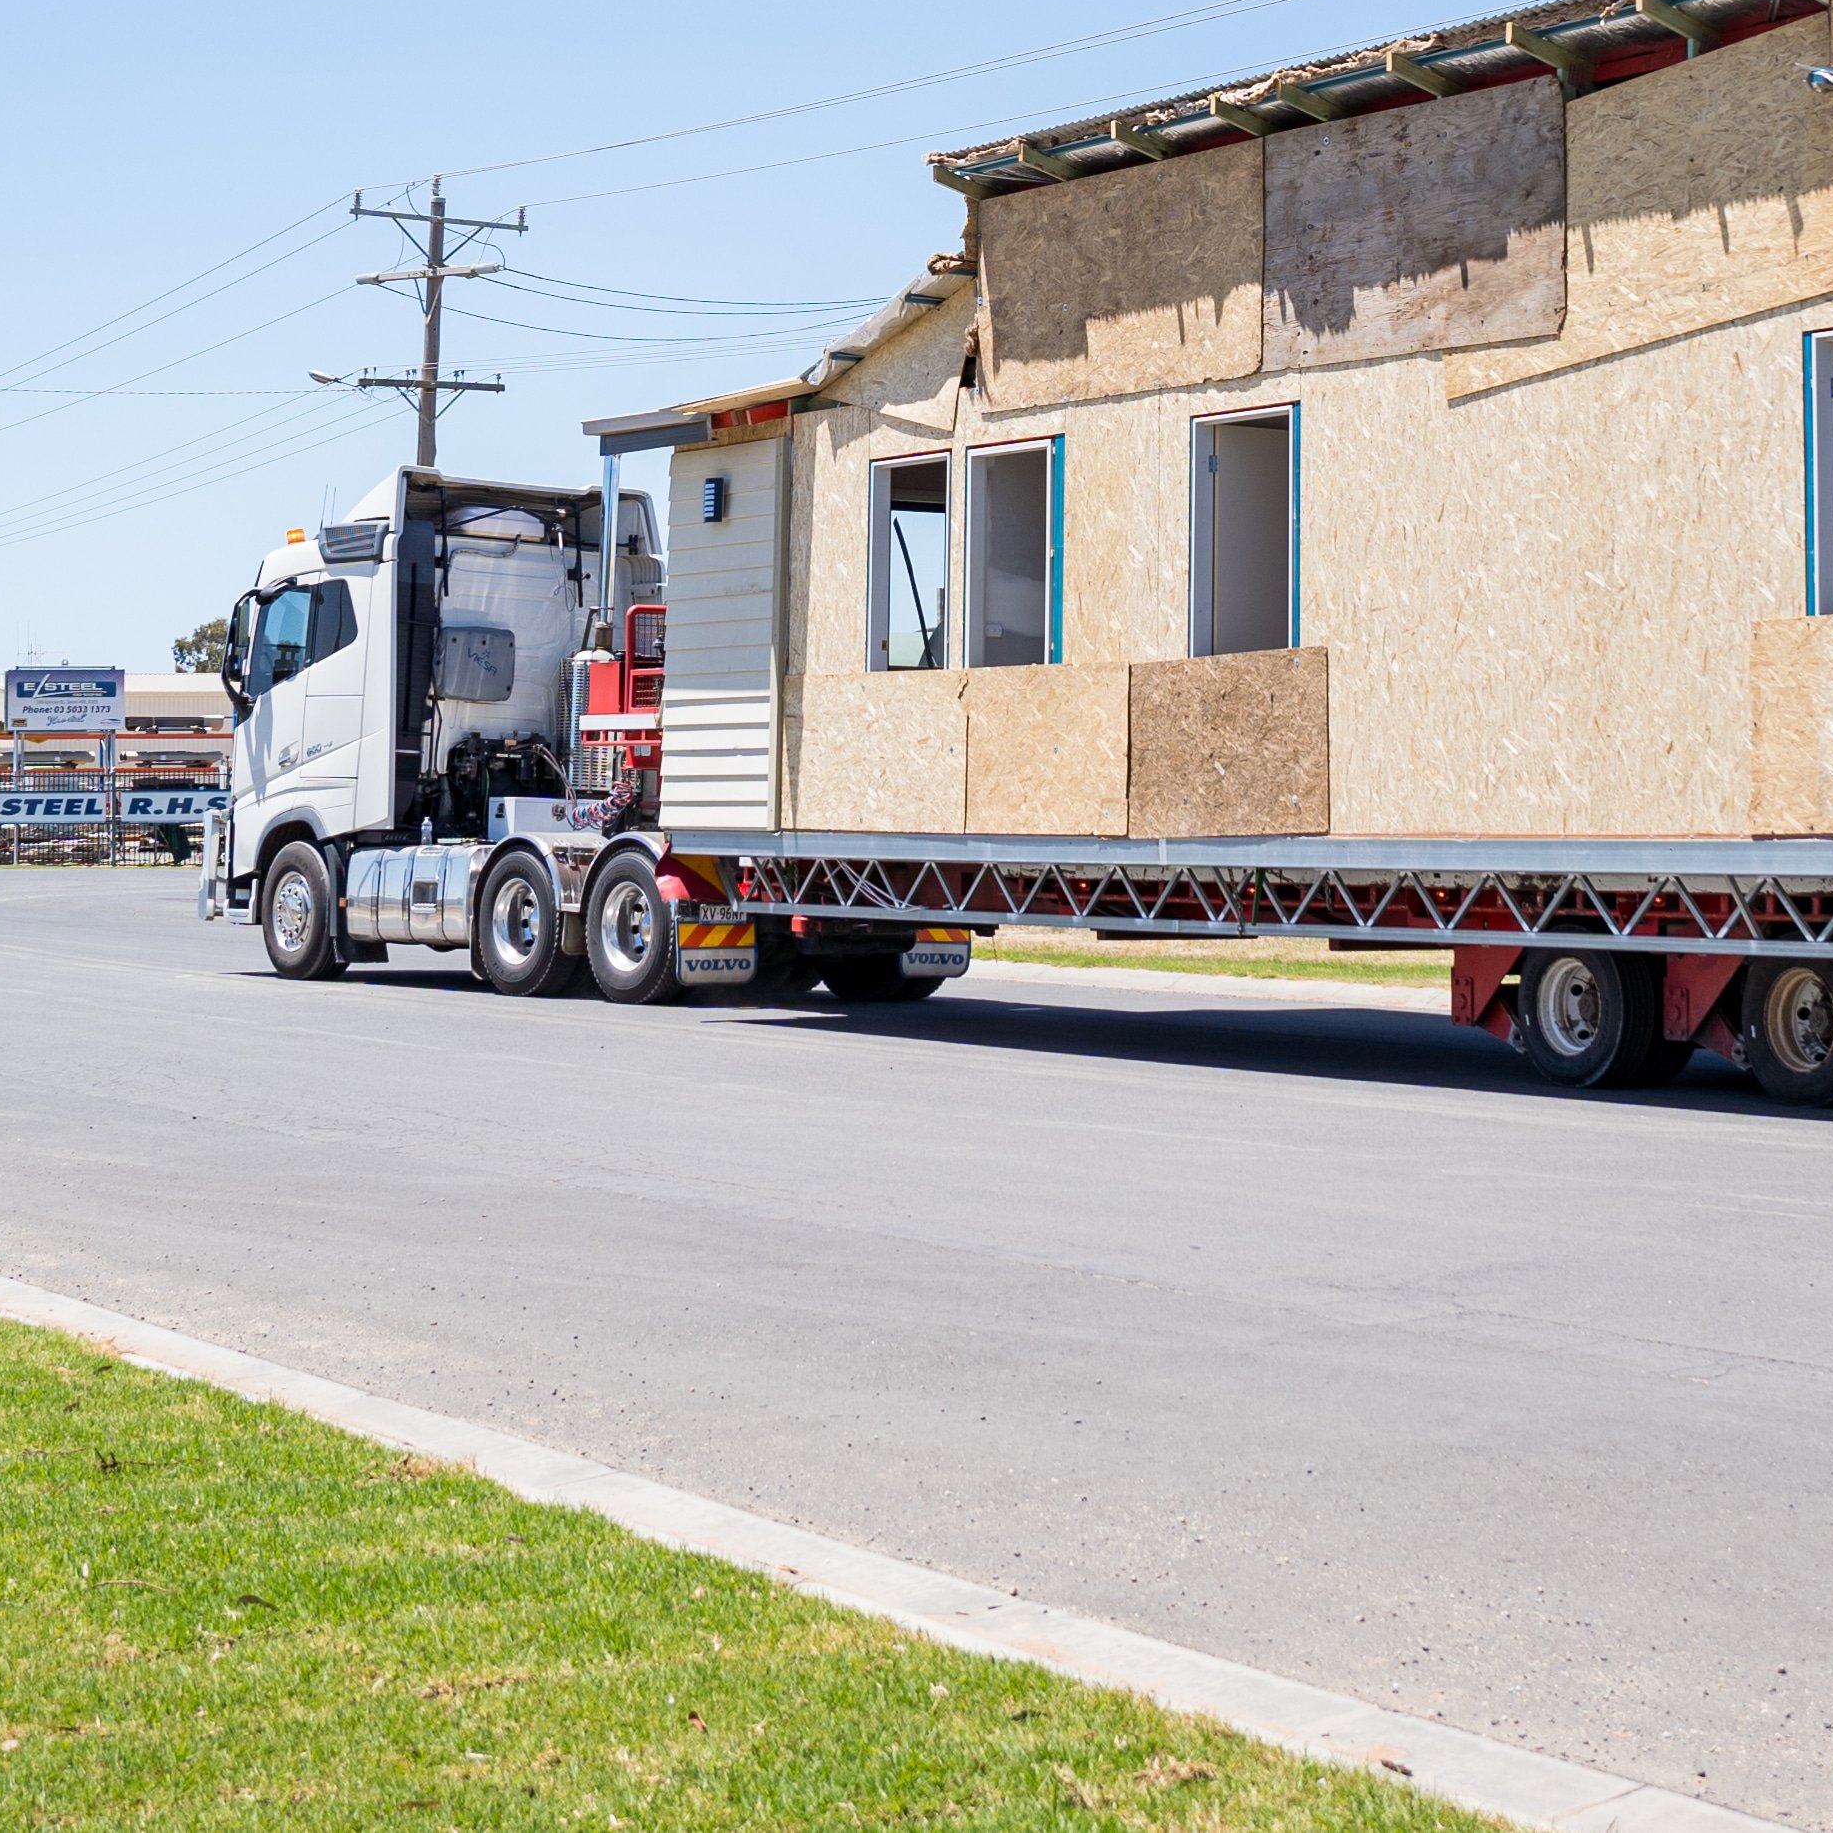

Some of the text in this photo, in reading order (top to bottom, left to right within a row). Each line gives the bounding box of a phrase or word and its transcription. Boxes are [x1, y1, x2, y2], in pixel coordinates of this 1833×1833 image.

[22, 705, 53, 714] Phone:
[53, 705, 65, 714] 03
[91, 705, 111, 714] 1373
[0, 798, 103, 815] STEEL
[685, 958, 751, 972] VOLVO
[906, 953, 964, 966] VOLVO
